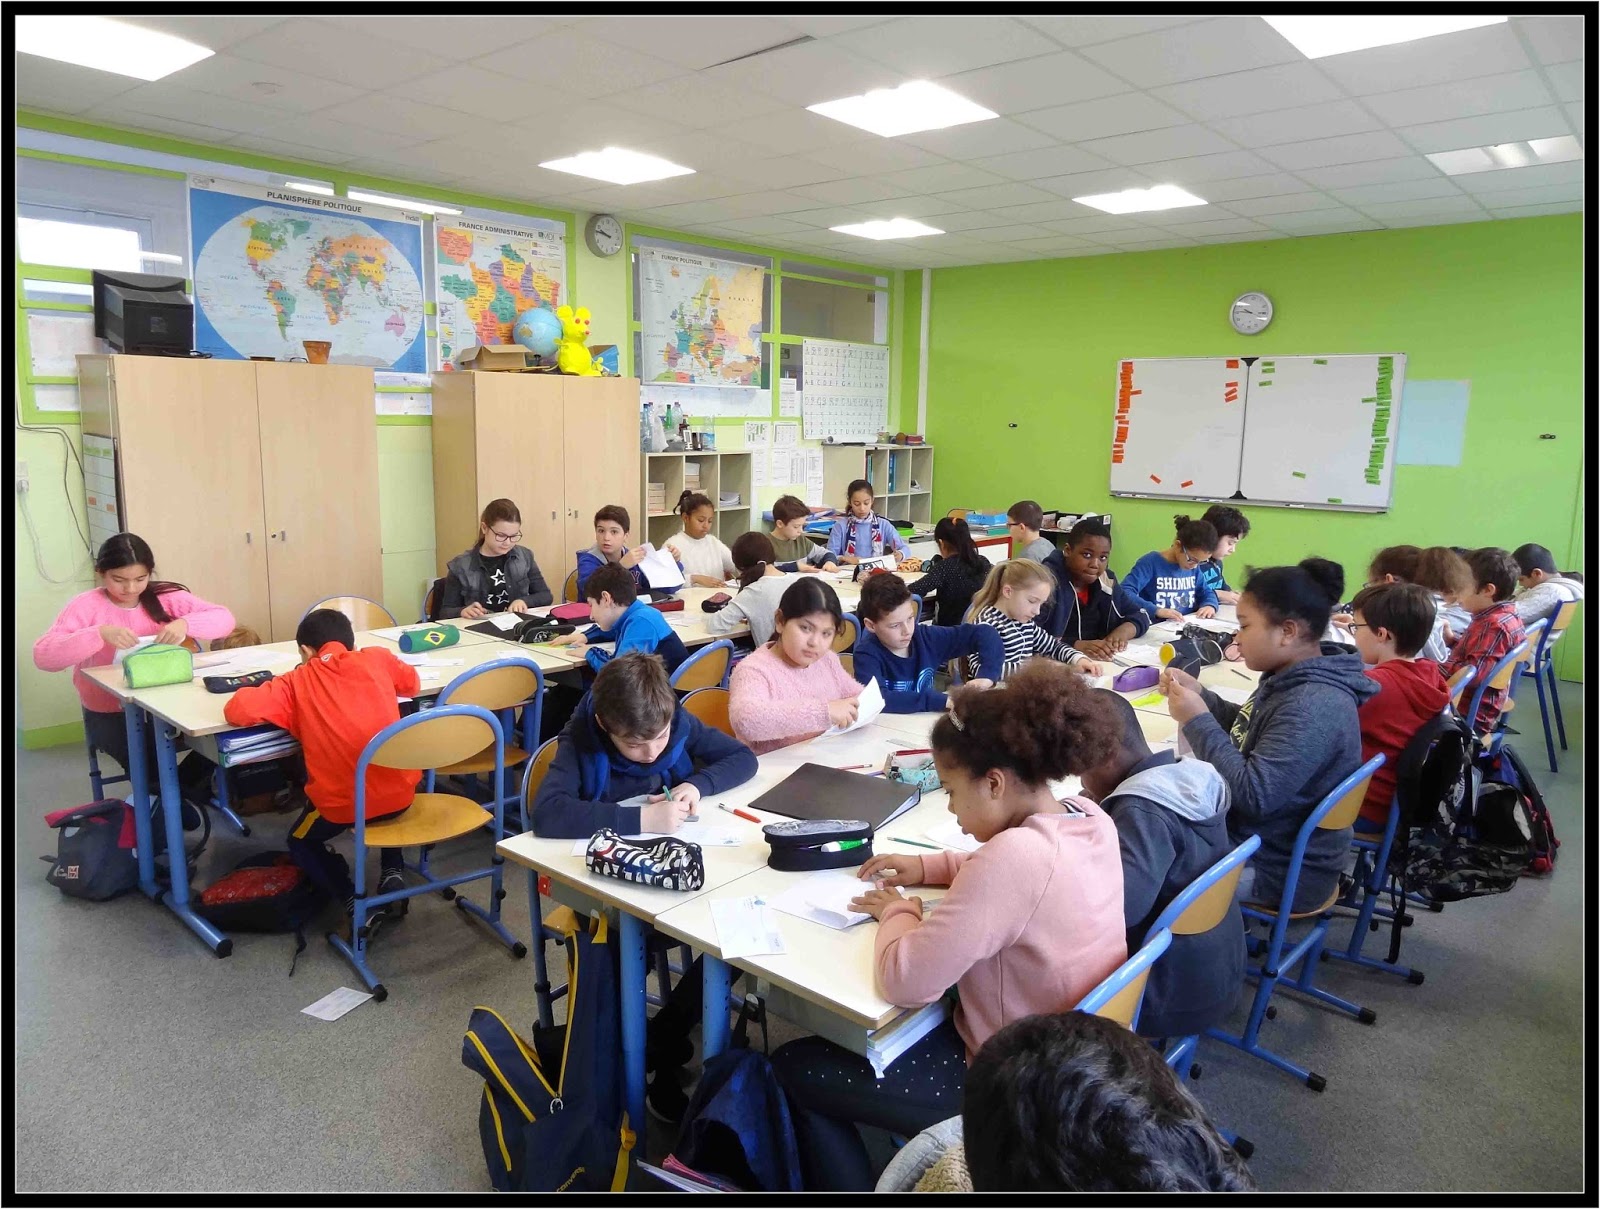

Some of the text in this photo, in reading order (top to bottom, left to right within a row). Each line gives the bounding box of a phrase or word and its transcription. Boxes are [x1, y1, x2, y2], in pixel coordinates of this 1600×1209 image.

[267, 191, 362, 213] PLANISPHÈRE POLITIQUE
[458, 221, 534, 239] FRANCE ADMINISTRATIVE
[661, 254, 702, 266] EUROPE POLITIQUE
